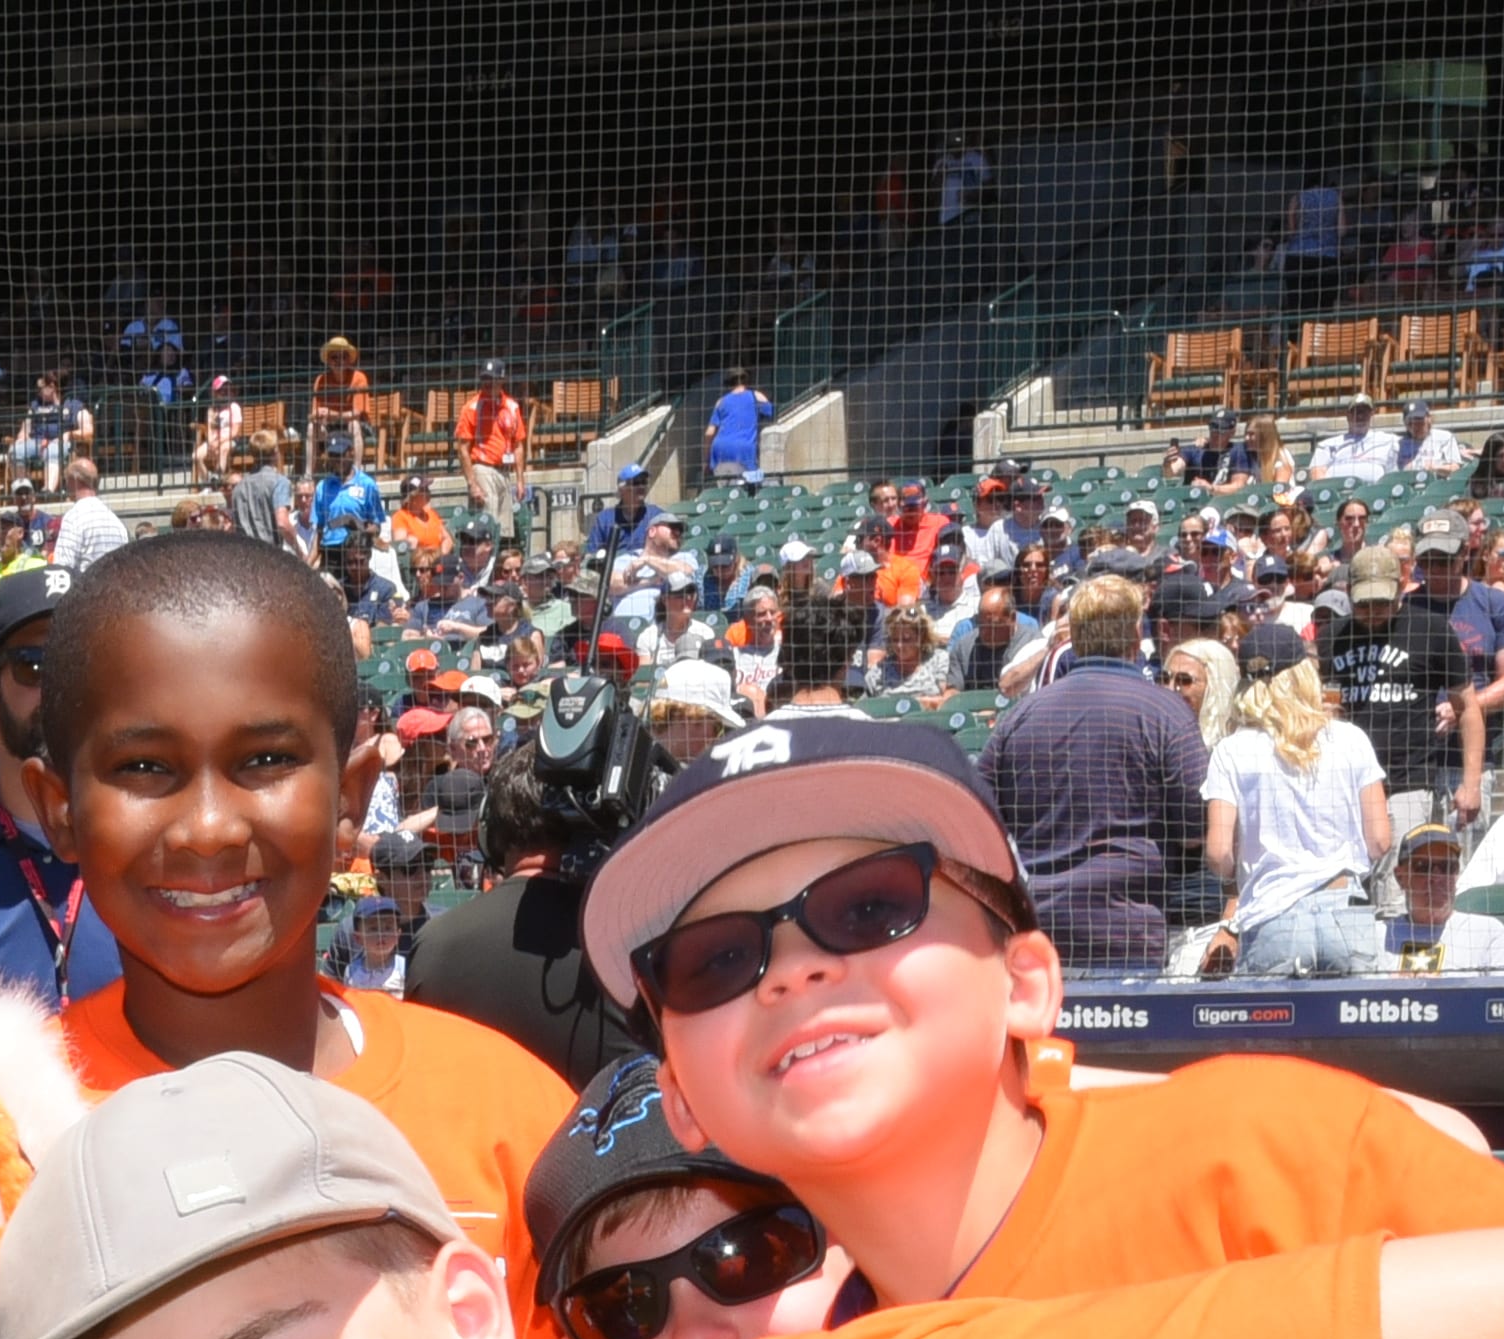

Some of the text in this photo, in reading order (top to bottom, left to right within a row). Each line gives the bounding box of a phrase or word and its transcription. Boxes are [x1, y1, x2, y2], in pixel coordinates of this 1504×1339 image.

[1333, 644, 1409, 674] DETROIT
[1055, 1003, 1149, 1030] bitbits
[1197, 1005, 1291, 1026] tigers.com
[1340, 999, 1440, 1025] bitbits
